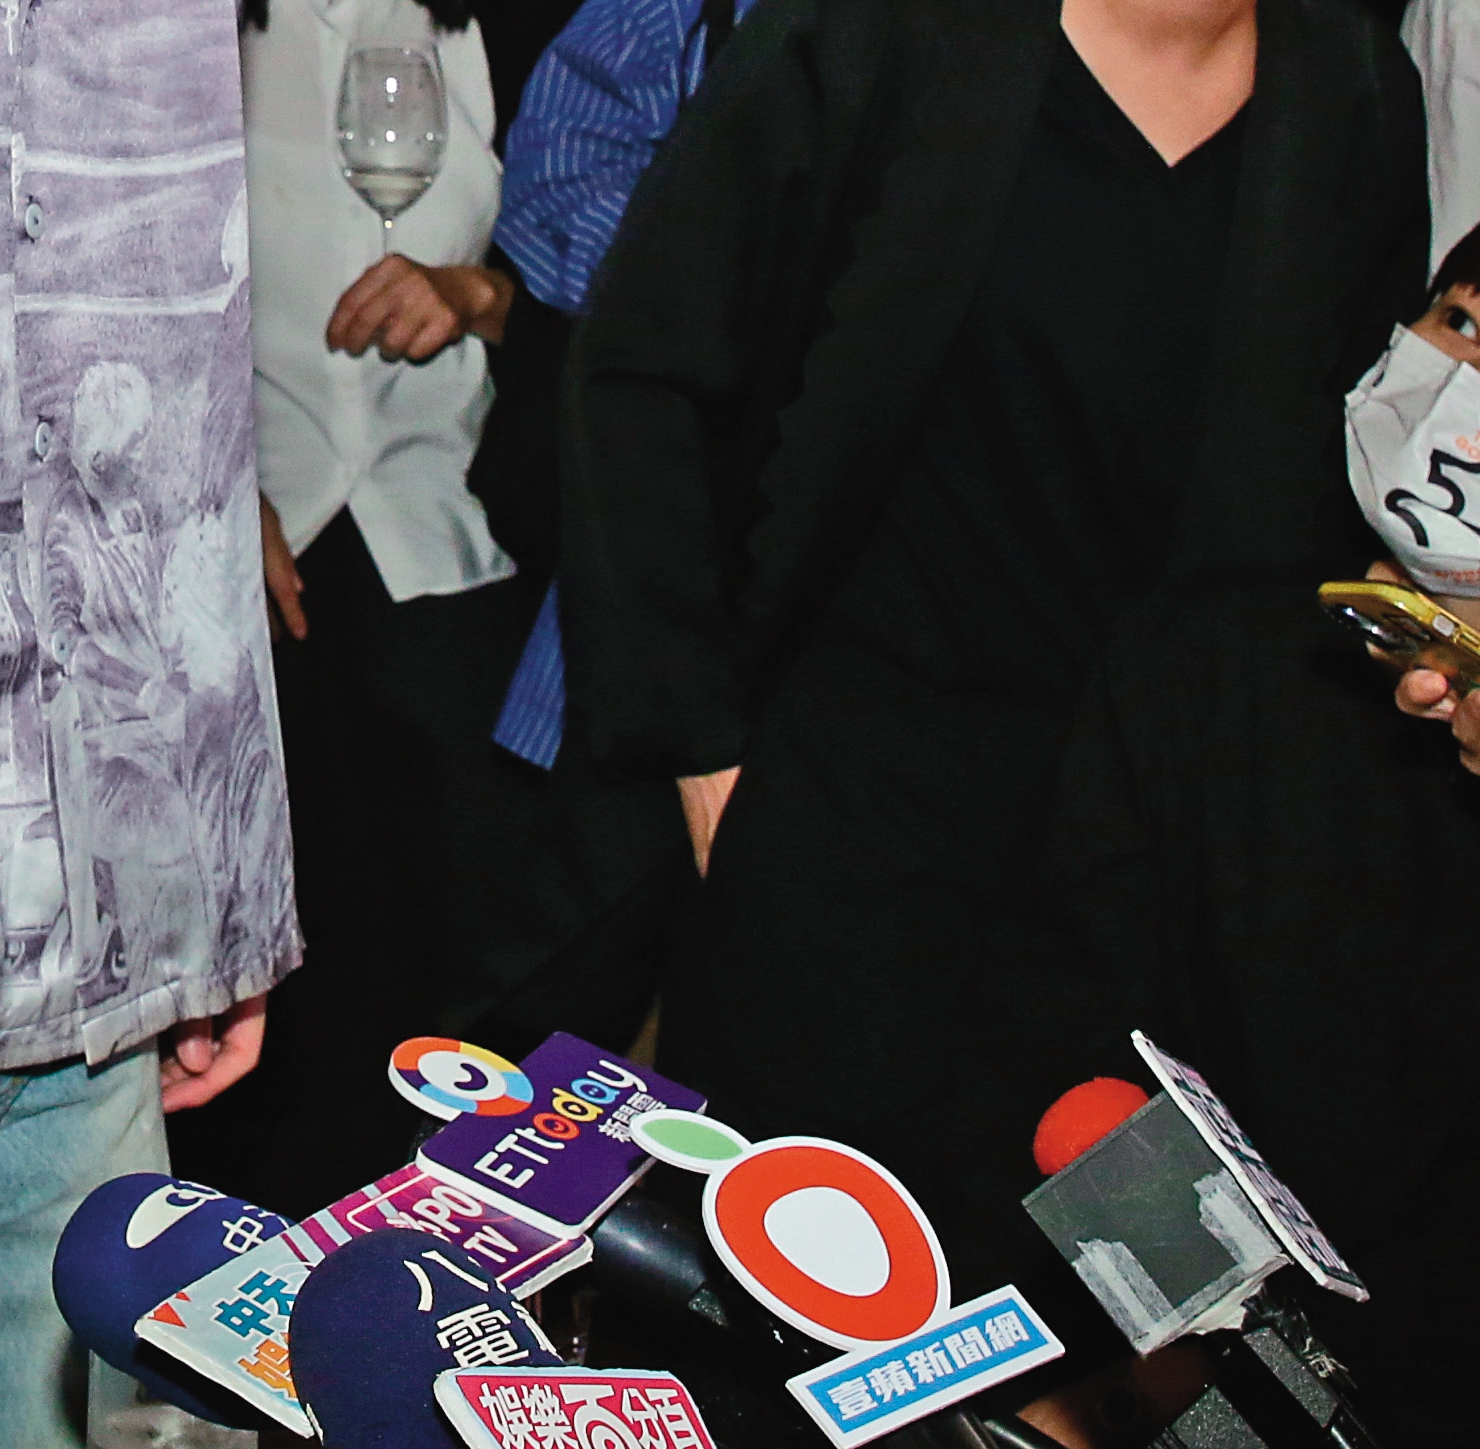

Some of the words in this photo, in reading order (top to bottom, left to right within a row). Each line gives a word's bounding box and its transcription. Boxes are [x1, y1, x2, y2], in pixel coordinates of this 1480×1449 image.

[473, 1059, 648, 1189] ETtoday
[222, 1205, 289, 1254] 中
[463, 1225, 518, 1263] TV
[213, 1269, 297, 1338] 中天
[826, 1310, 1030, 1421] 壹蘋新聞網
